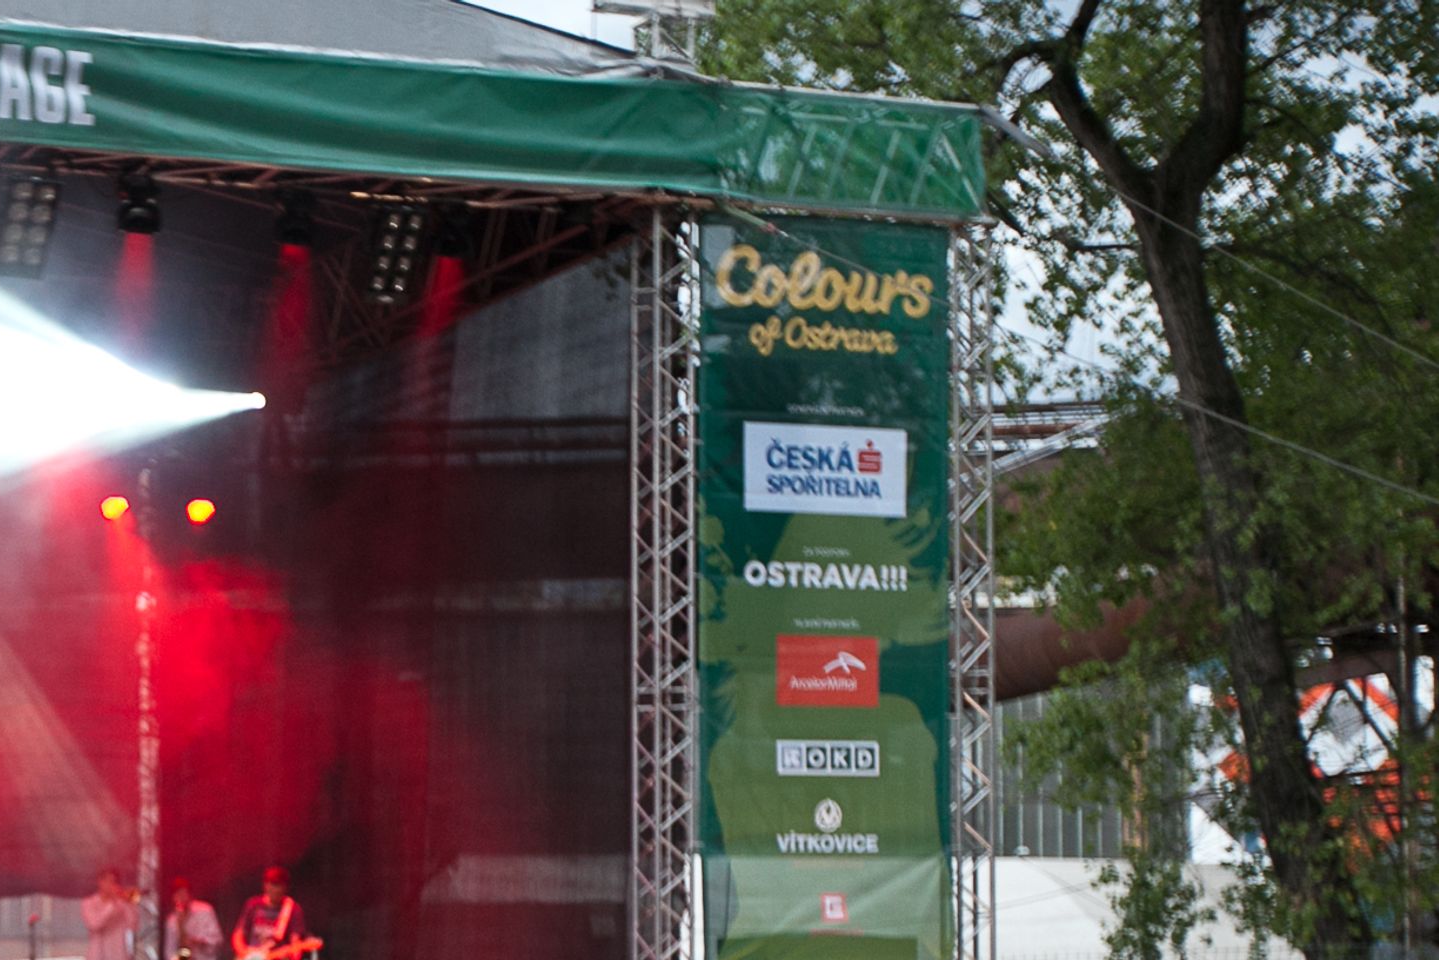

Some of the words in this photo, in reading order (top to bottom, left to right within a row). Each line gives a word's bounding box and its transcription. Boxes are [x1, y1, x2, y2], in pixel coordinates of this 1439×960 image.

[715, 243, 934, 319] Colours
[748, 315, 781, 357] of
[784, 316, 899, 355] Ostrava
[766, 436, 855, 473] ČESKÁ
[766, 470, 883, 498] SPOŘITELNA
[743, 560, 908, 591] OSTRAVA!!!
